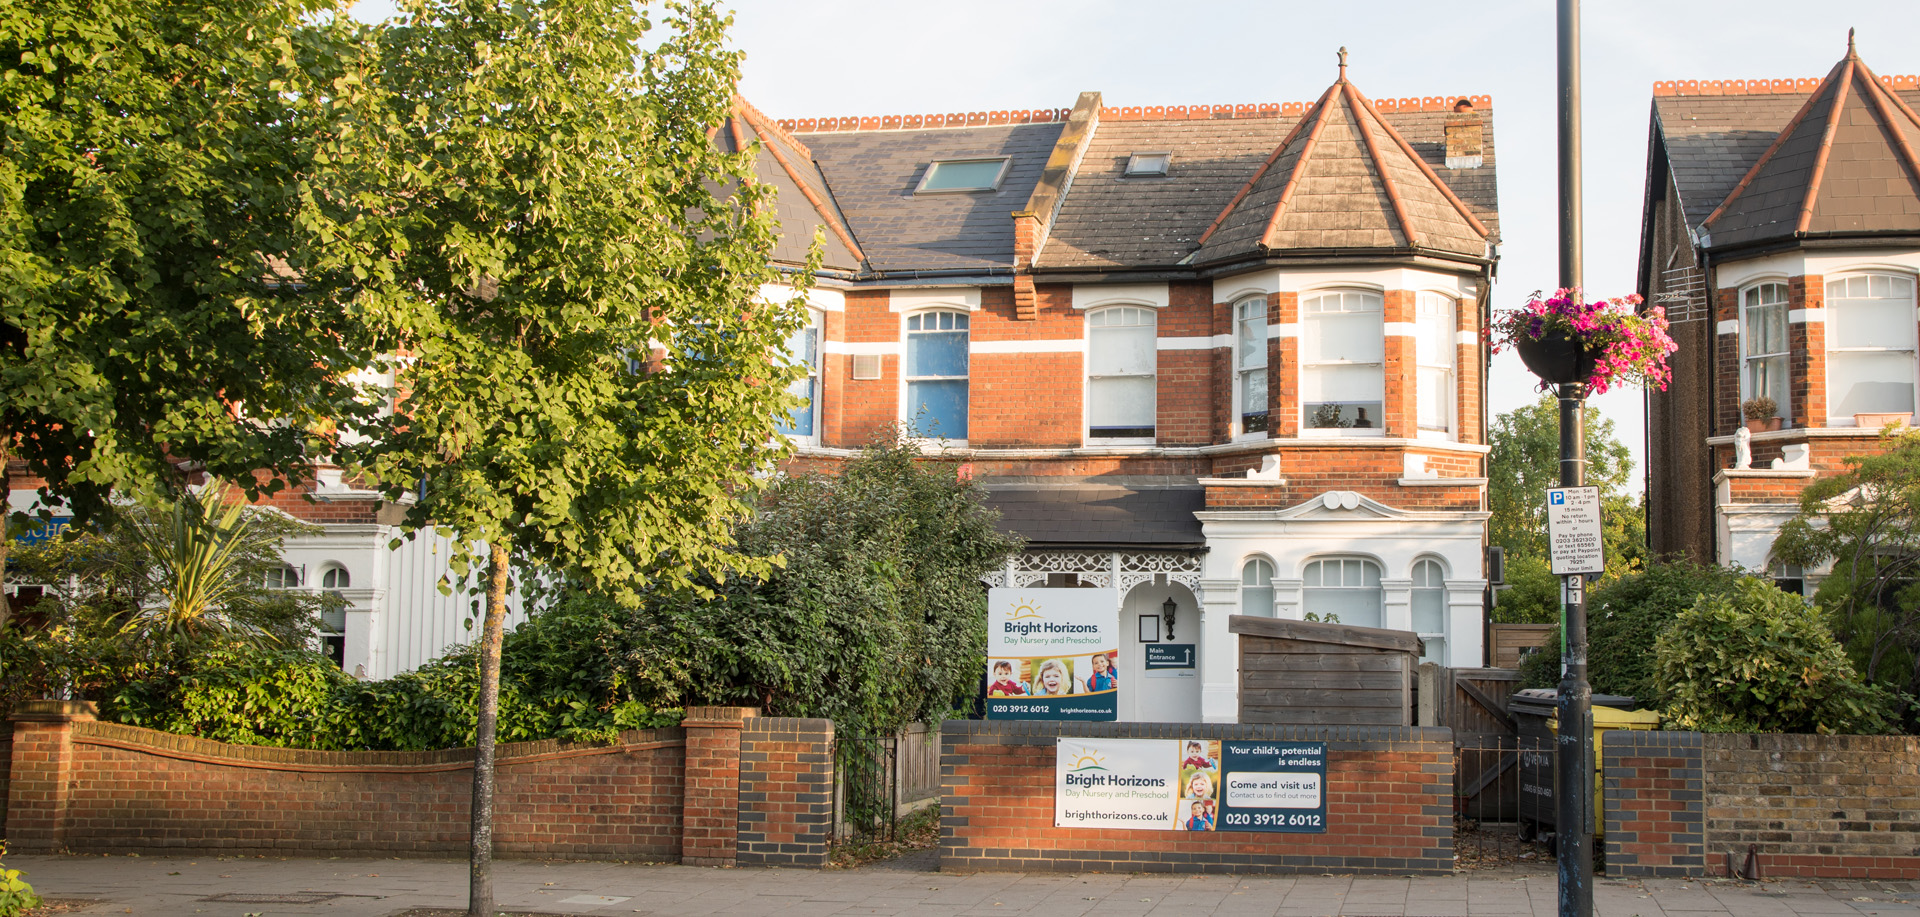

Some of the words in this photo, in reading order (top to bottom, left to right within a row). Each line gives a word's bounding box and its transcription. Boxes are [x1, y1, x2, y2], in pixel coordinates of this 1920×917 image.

[1554, 493, 1562, 504] P
[1571, 577, 1578, 586] 2
[1572, 593, 1577, 601] 1
[1004, 622, 1041, 636] Bright
[1044, 622, 1098, 633] Horizons
[1004, 637, 1018, 645] Day
[1020, 637, 1049, 645] Nursery
[1230, 746, 1250, 754] Your
[1281, 747, 1321, 756] potential
[1278, 758, 1285, 766] is
[1288, 758, 1321, 766] endless
[1066, 774, 1105, 788] Bright
[1108, 775, 1165, 787] Horizons
[1230, 781, 1257, 789] Come
[1260, 781, 1277, 789] and
[1281, 781, 1300, 789] visit
[1065, 789, 1080, 799] Day
[1082, 789, 1113, 799] Nursery
[1115, 790, 1130, 798] and
[1132, 791, 1169, 799] Preschool
[1065, 810, 1168, 821] brighthorizons.co.uk
[1226, 813, 1250, 825] 020
[1254, 814, 1285, 825] 3912
[1289, 814, 1321, 826] 6012
